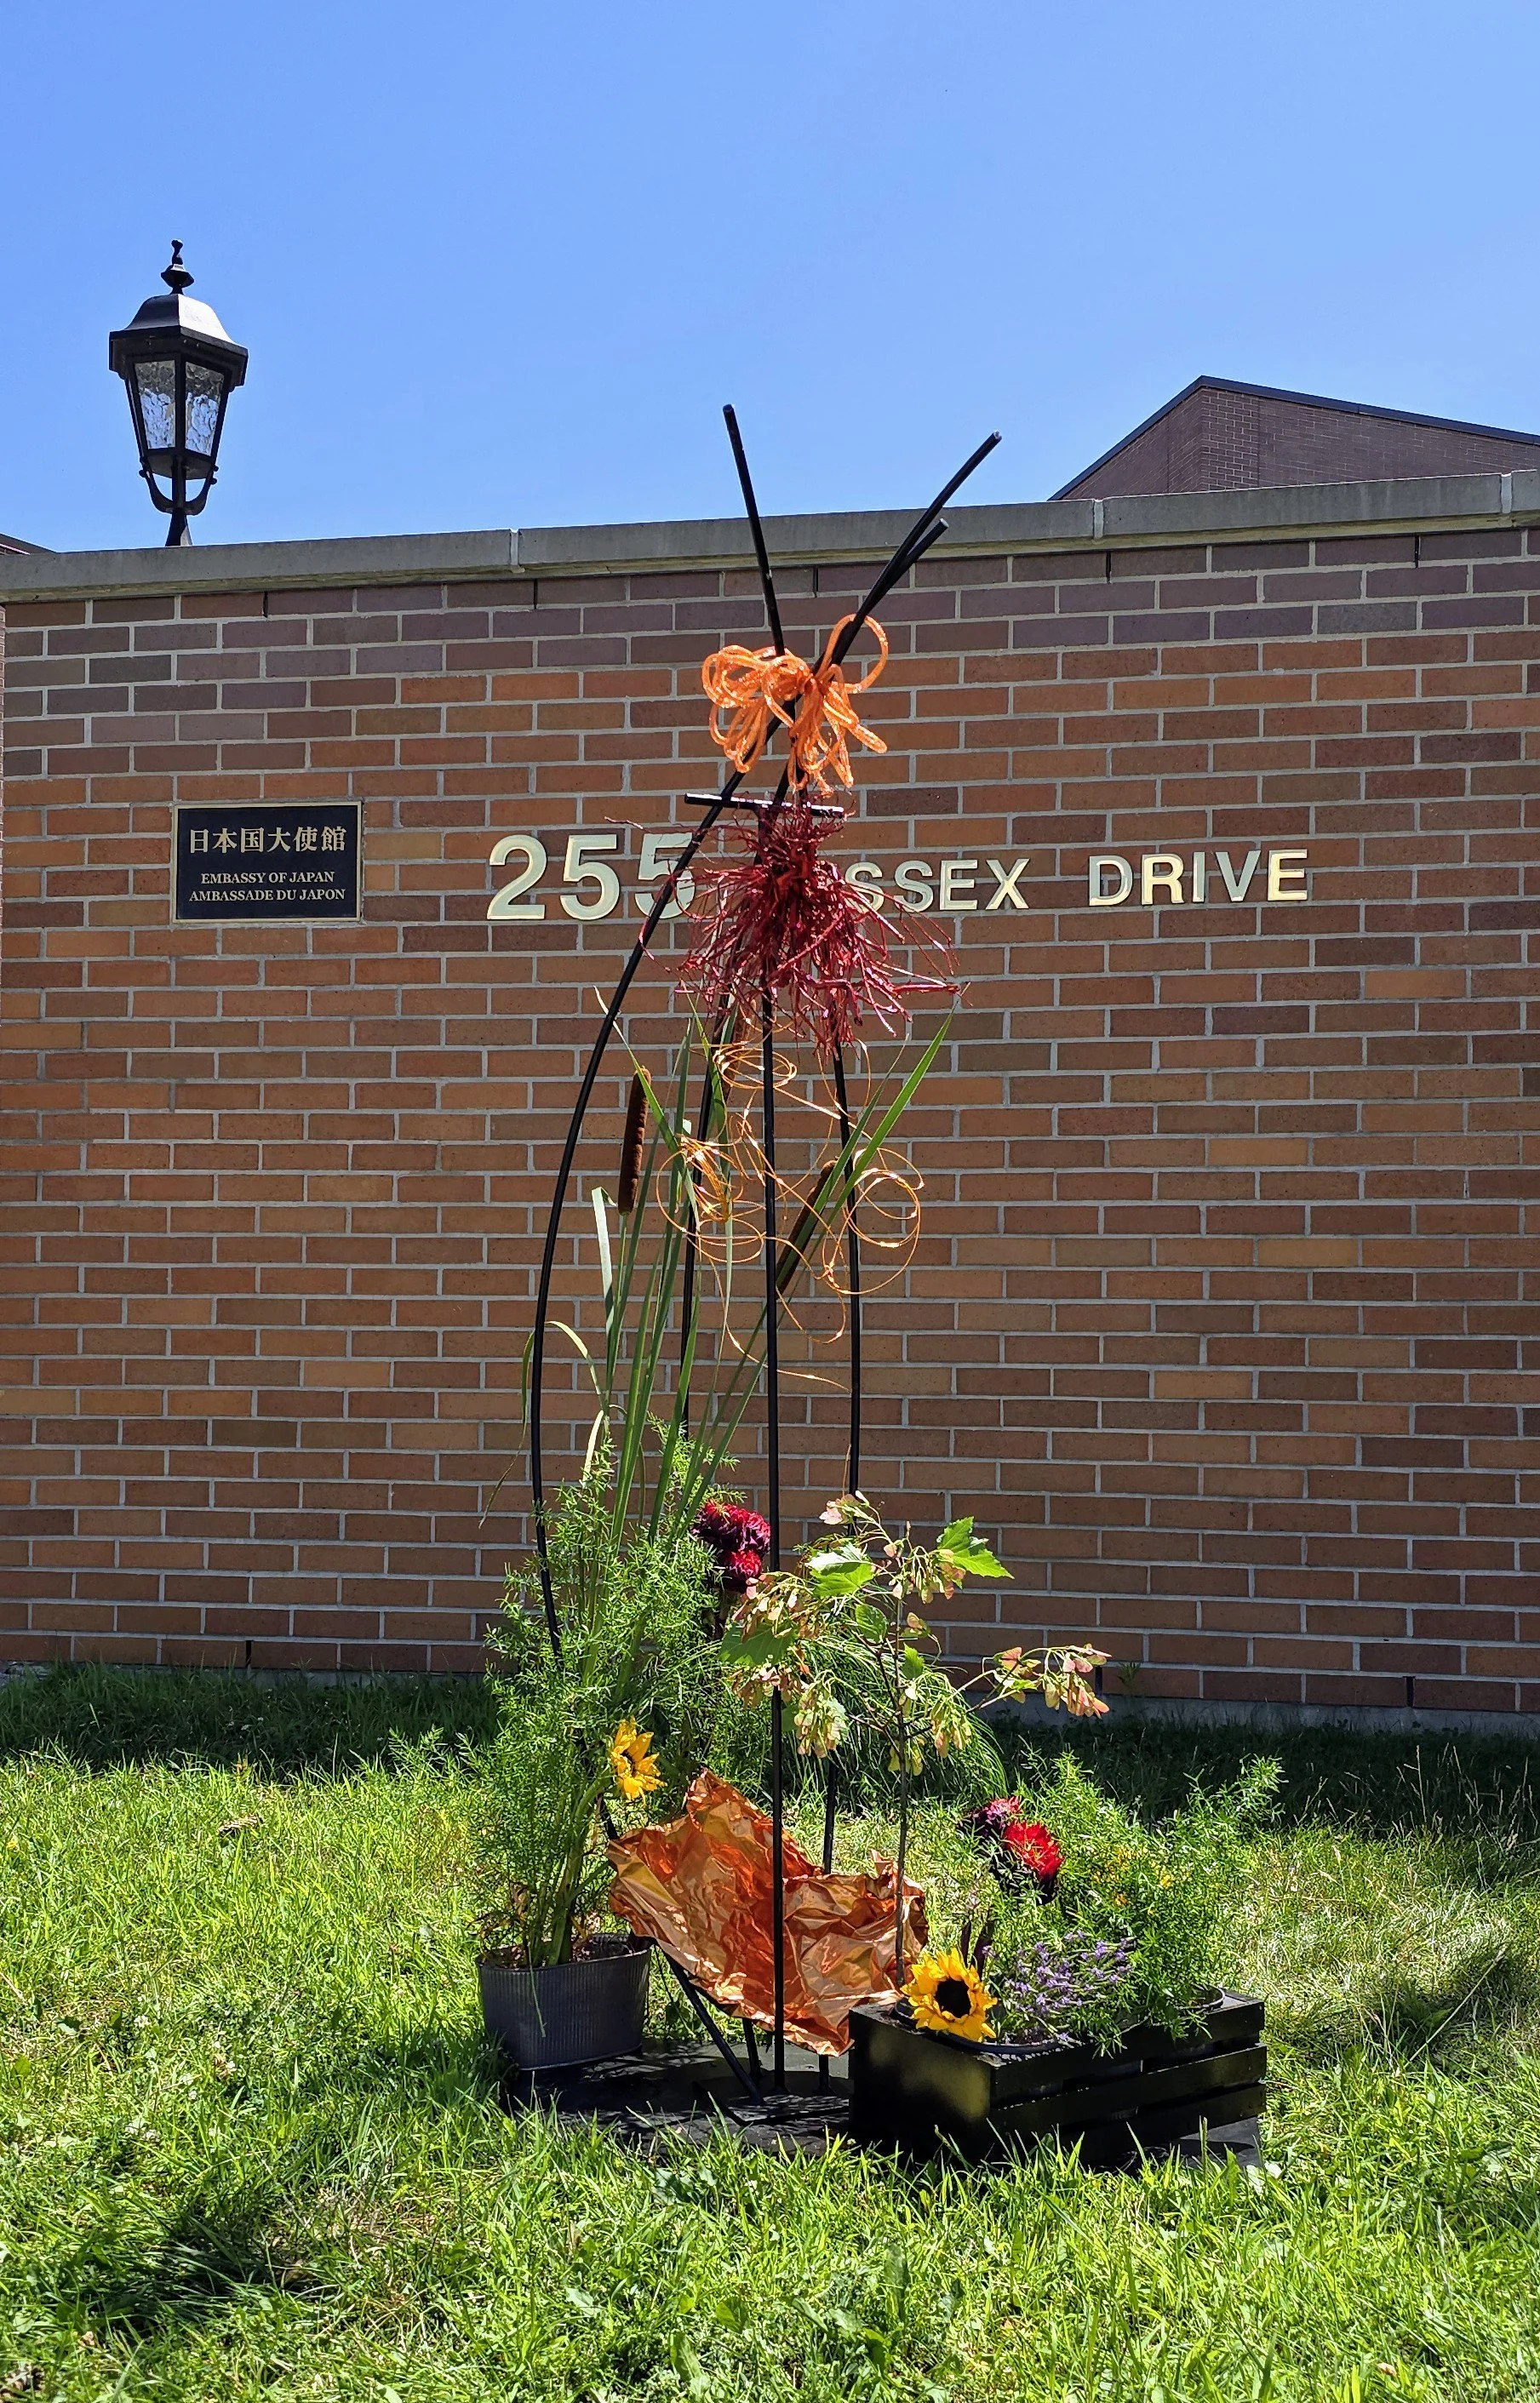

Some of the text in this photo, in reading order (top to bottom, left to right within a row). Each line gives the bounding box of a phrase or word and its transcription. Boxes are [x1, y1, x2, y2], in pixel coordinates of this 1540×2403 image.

[189, 826, 347, 854] 日本国大使館
[200, 871, 335, 884] EMBASSY OF JAPAN
[486, 832, 696, 921] 255
[1088, 849, 1308, 907] DRIVE
[188, 888, 346, 902] AMBASSADE DU JAPON
